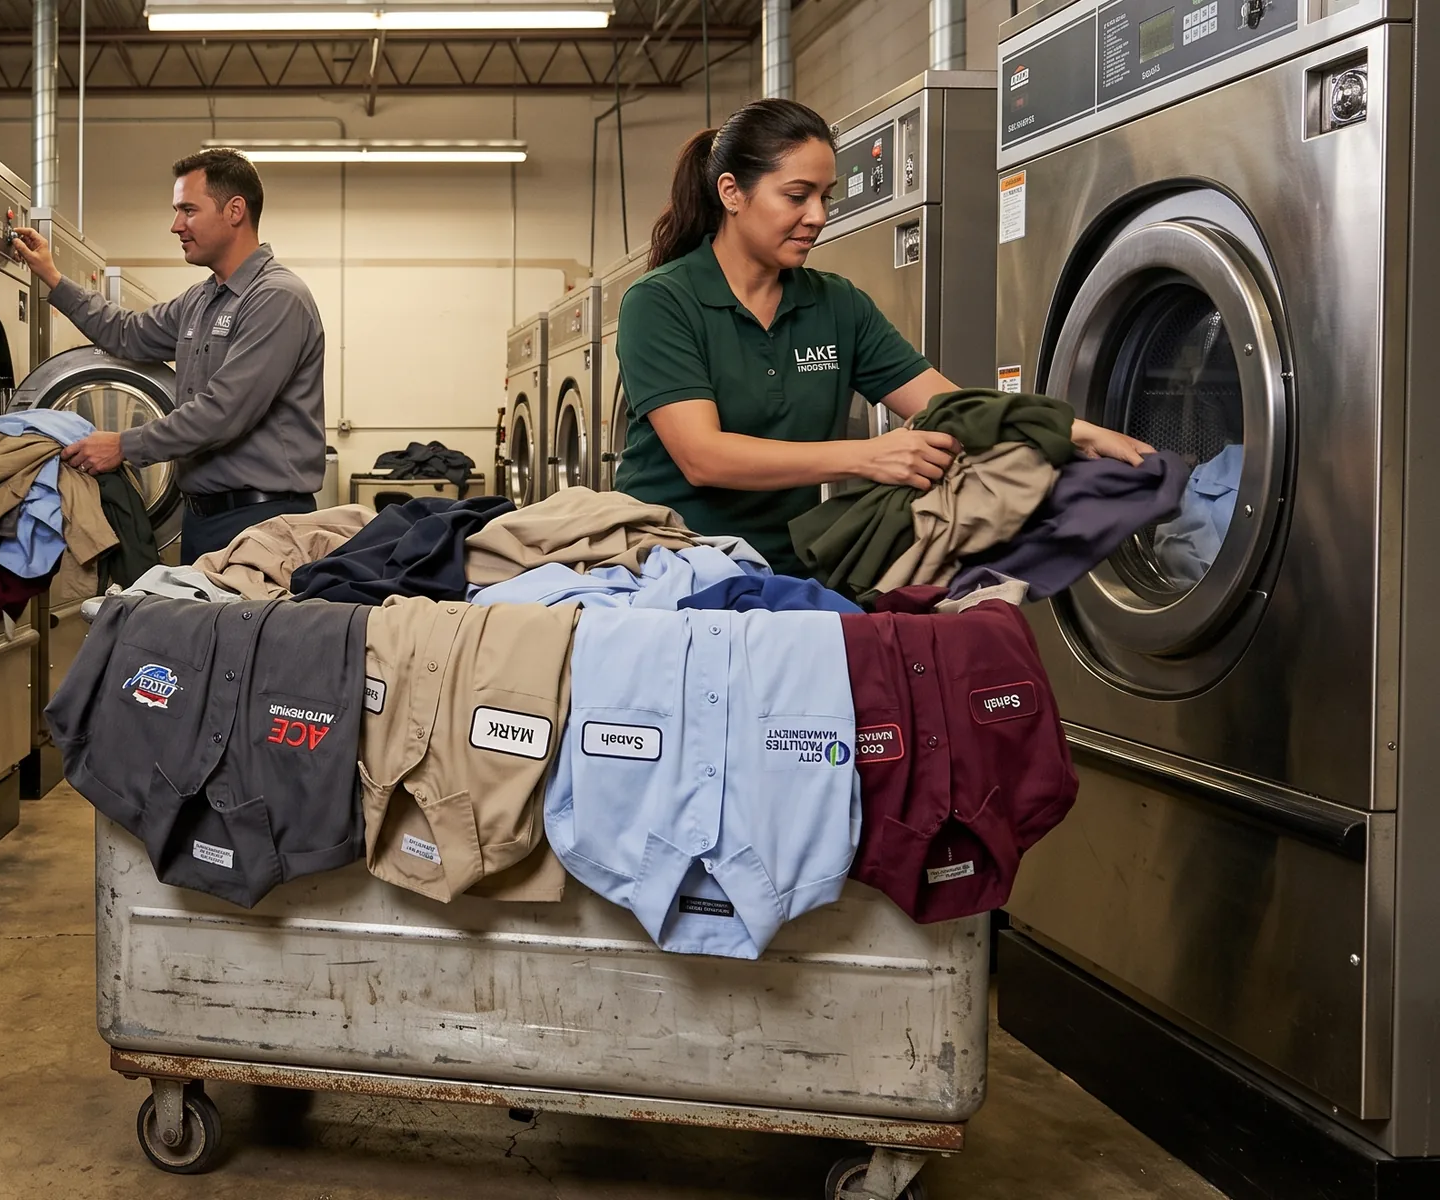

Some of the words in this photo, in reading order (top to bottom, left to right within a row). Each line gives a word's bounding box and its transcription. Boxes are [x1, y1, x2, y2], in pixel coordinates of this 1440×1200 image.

[794, 345, 837, 362] LAKE
[267, 717, 330, 751] ACE
[486, 721, 535, 744] MARK
[798, 752, 823, 763] CITY
